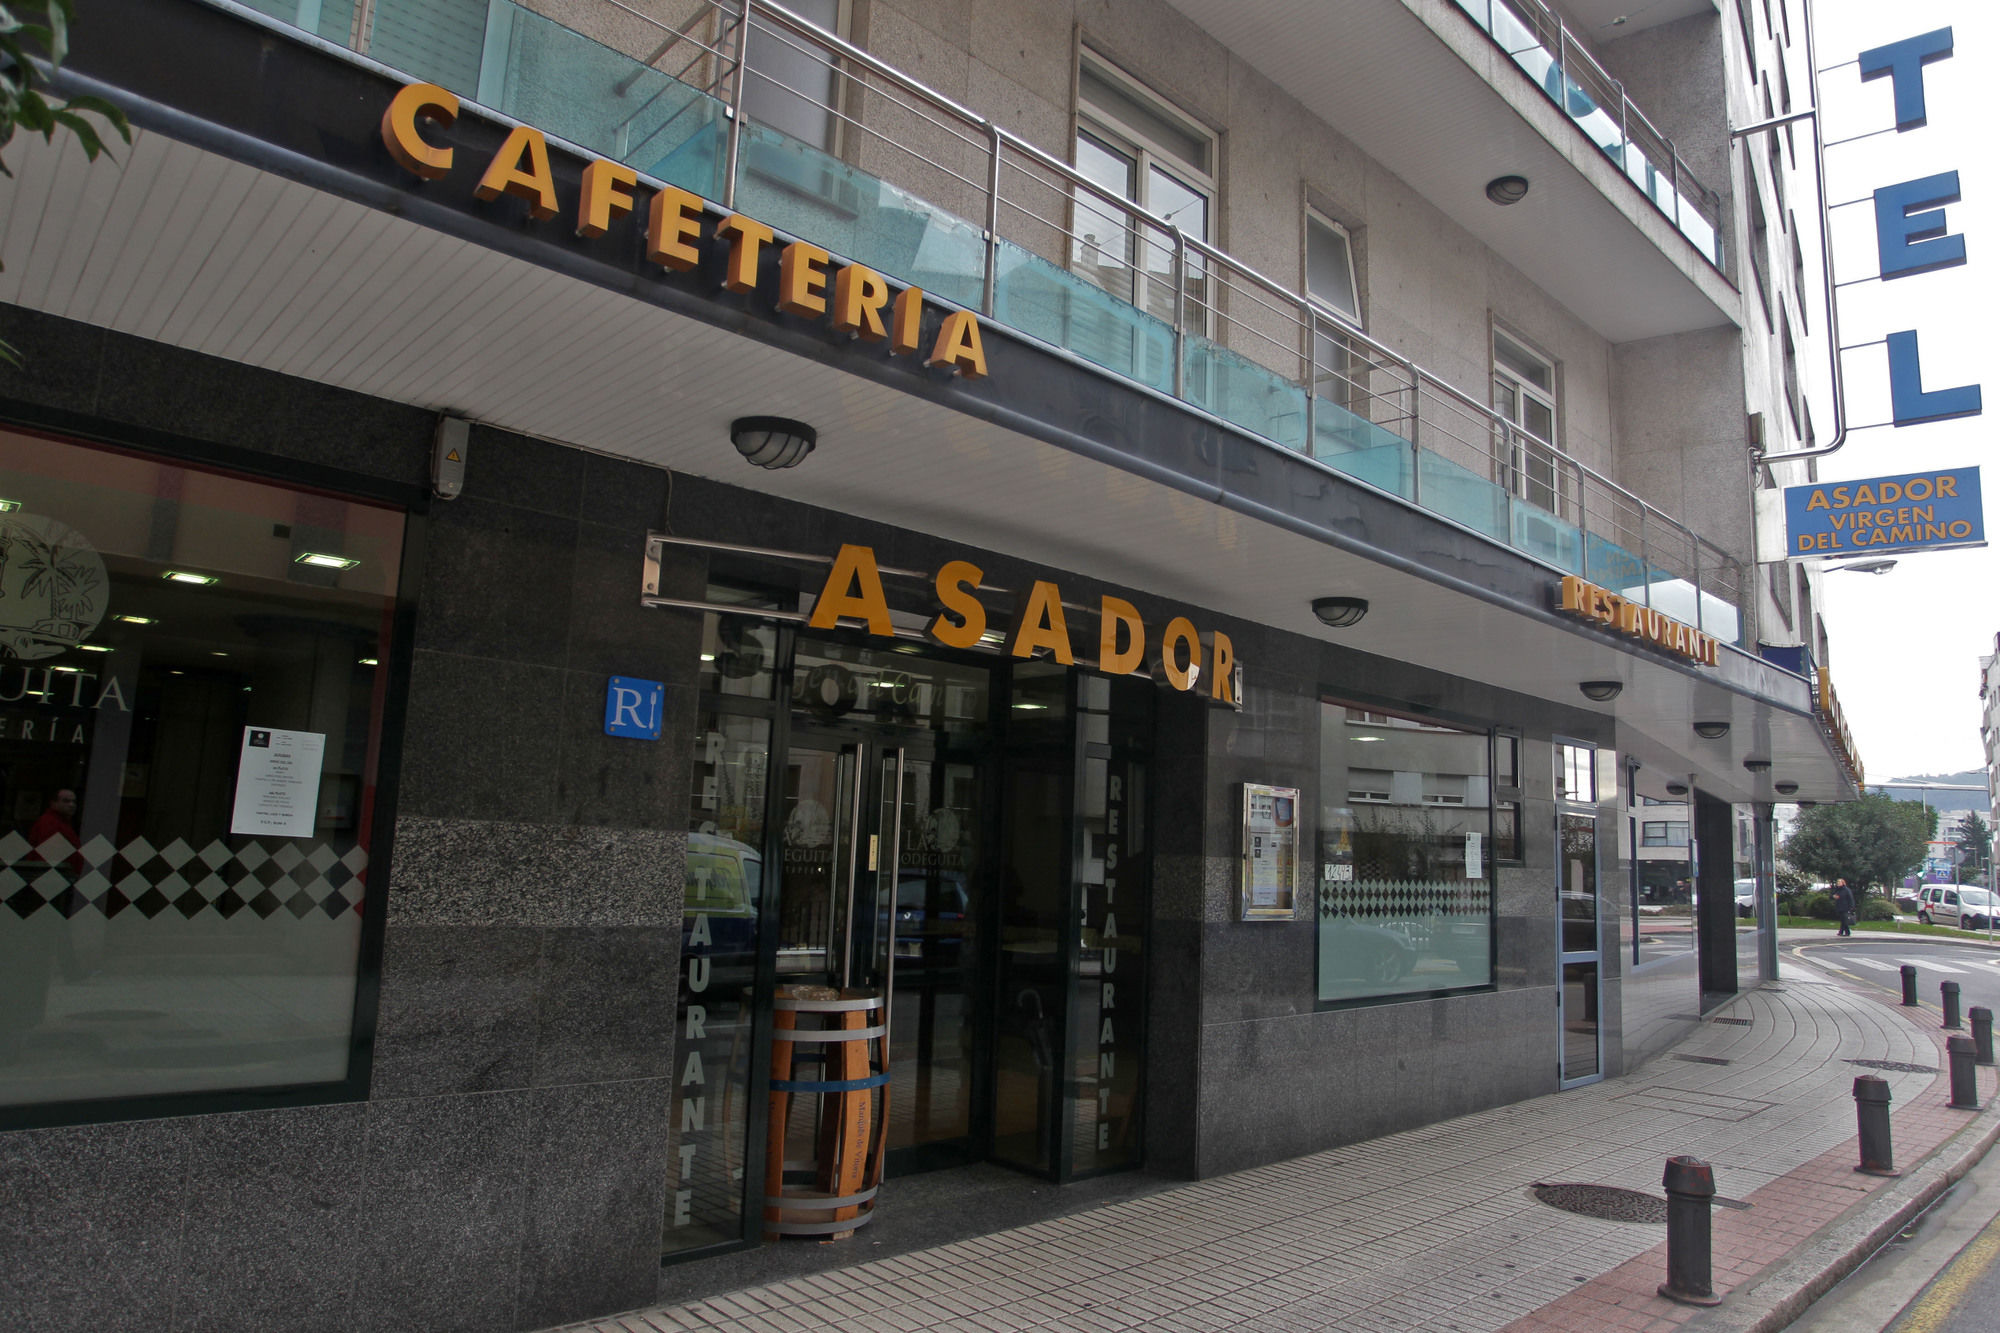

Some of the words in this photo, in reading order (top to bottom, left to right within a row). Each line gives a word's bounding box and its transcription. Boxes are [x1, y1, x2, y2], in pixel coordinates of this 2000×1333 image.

[381, 83, 989, 381] CAFETERIA
[1798, 531, 1843, 551] DEL
[1851, 519, 1972, 547] CAMINO
[1806, 475, 1959, 512] ASADOR
[1828, 505, 1934, 530] VIRGEN
[808, 543, 1234, 703] ASADOR
[1562, 576, 1721, 667] RESTAURANTE
[673, 732, 727, 1227] RESTAURANTE
[1098, 775, 1123, 1150] RESTAURANTE
